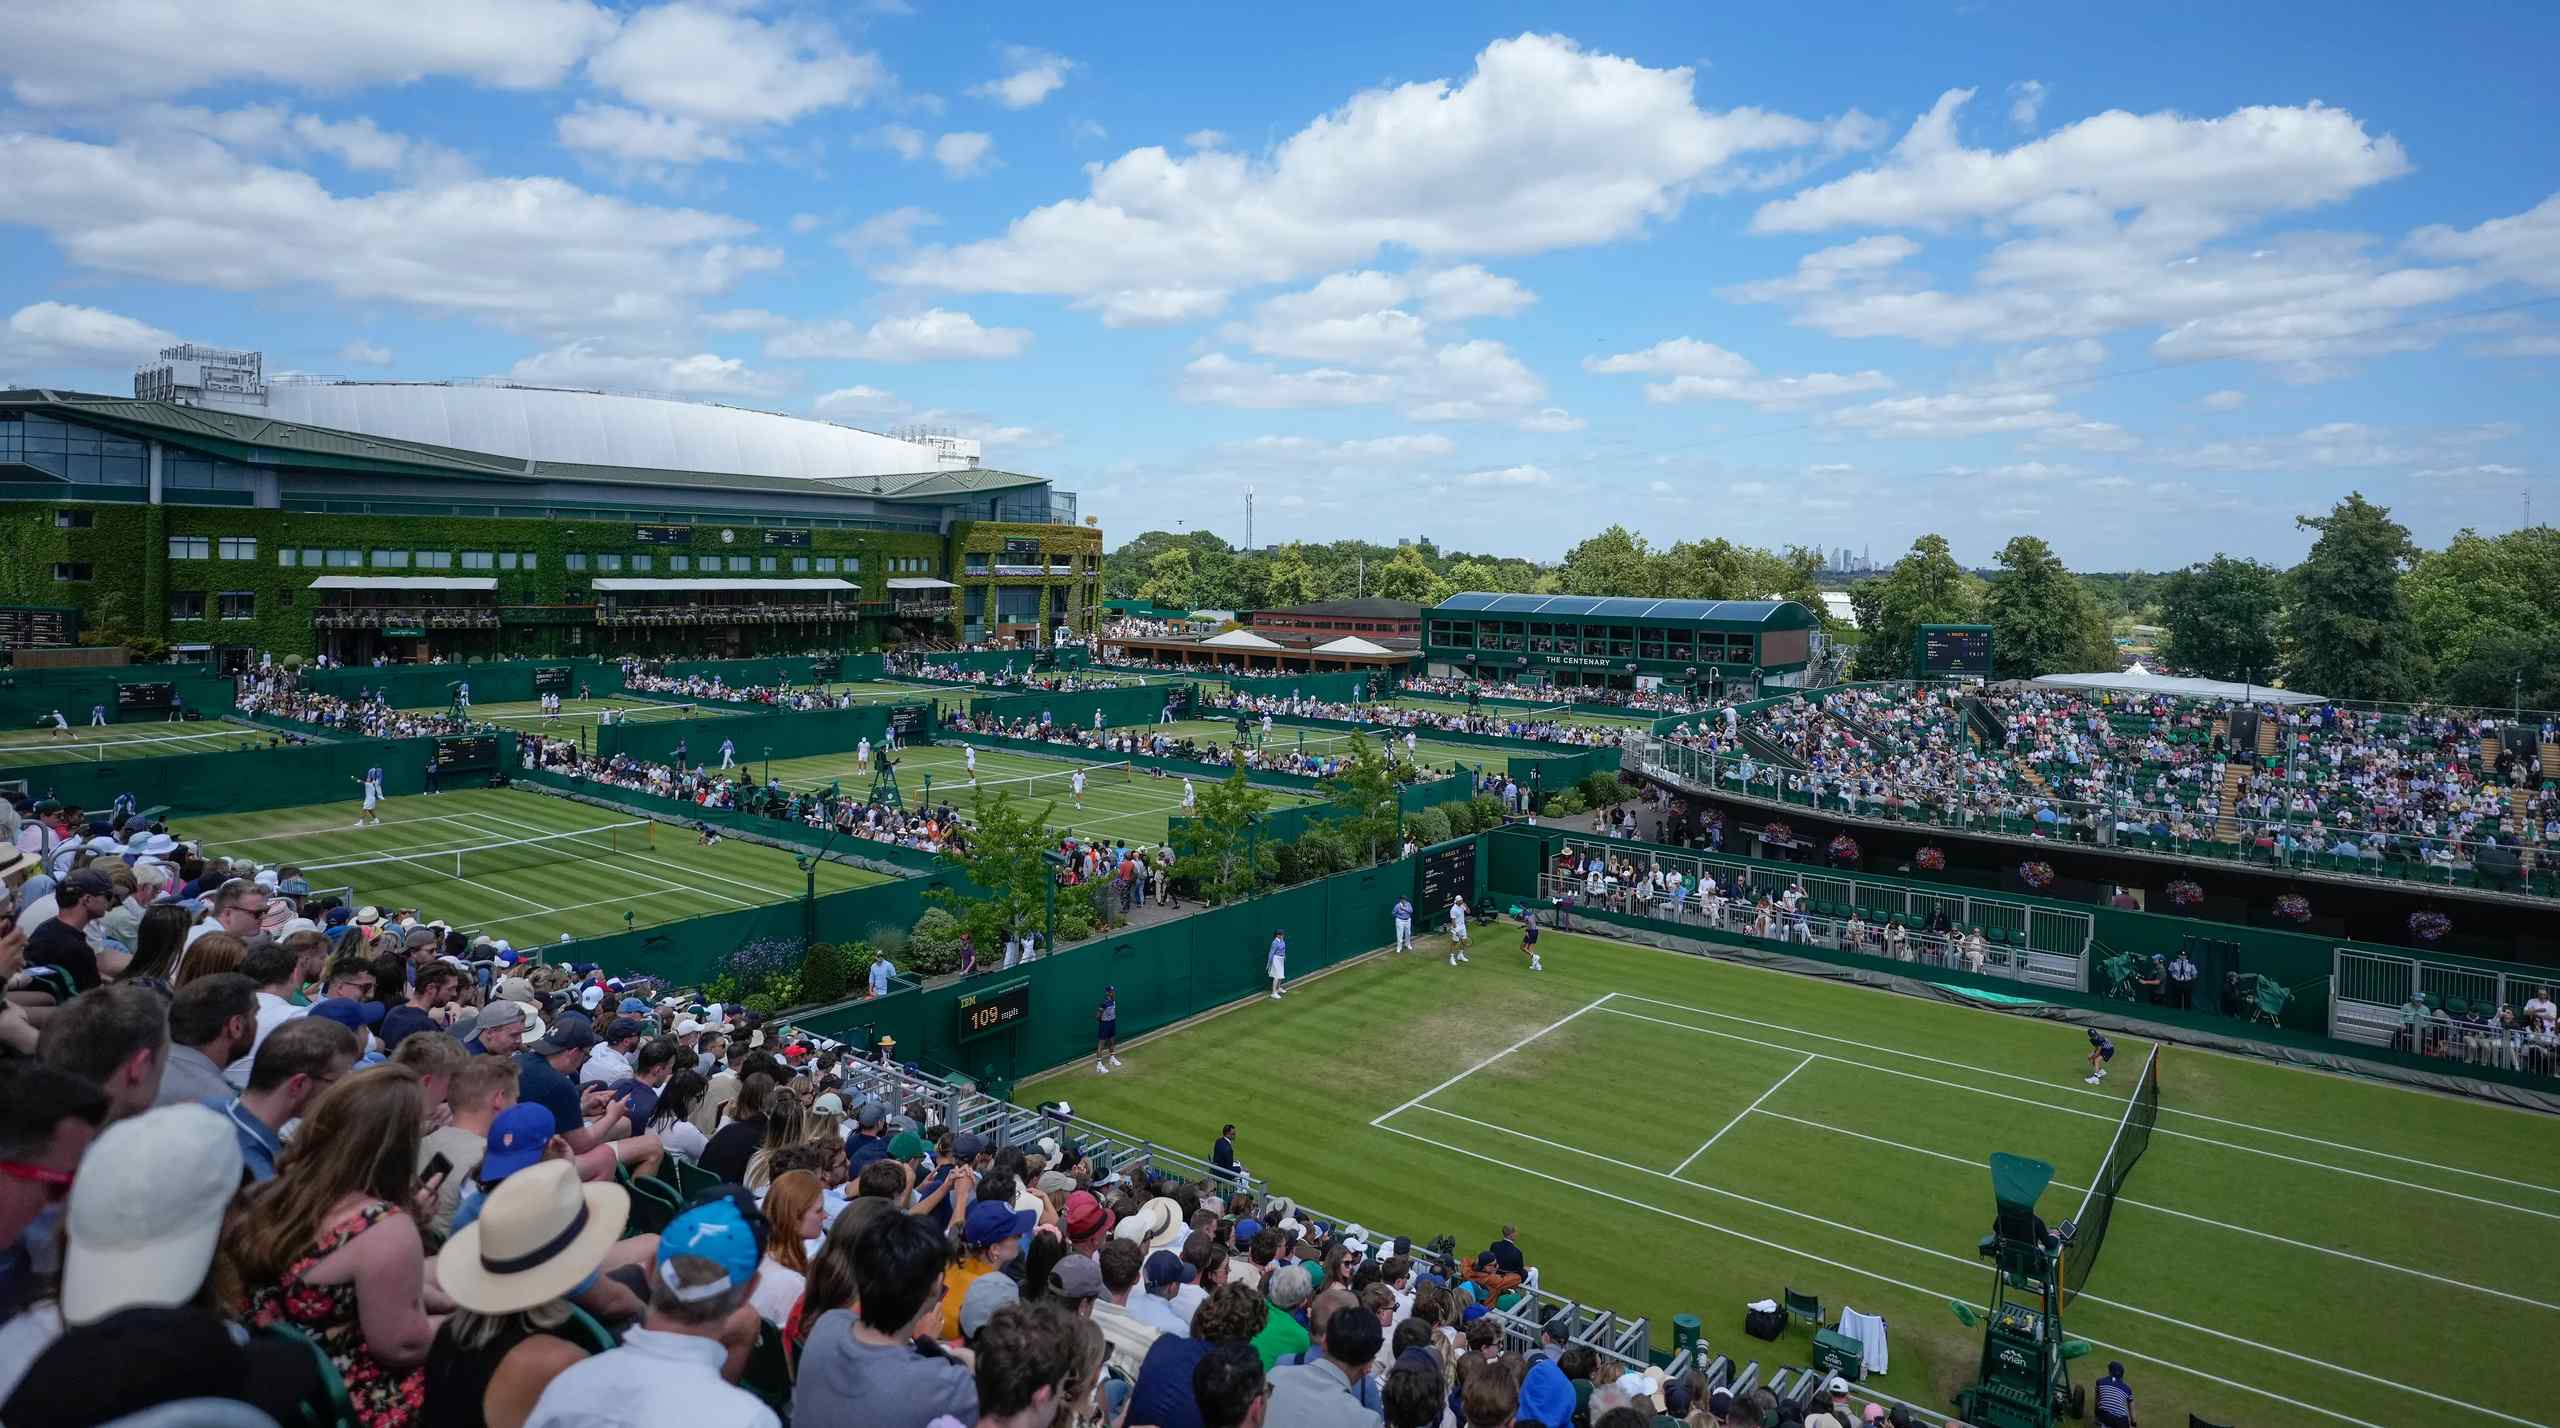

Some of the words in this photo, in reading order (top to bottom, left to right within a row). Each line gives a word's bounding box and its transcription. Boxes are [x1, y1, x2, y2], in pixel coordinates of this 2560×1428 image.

[1546, 656, 1561, 664] THE
[1563, 657, 1610, 666] CENTENARY
[960, 995, 976, 1009] IBM
[971, 1006, 998, 1029] 109
[1001, 1007, 1019, 1020] mph
[2000, 1351, 2027, 1367] evian
